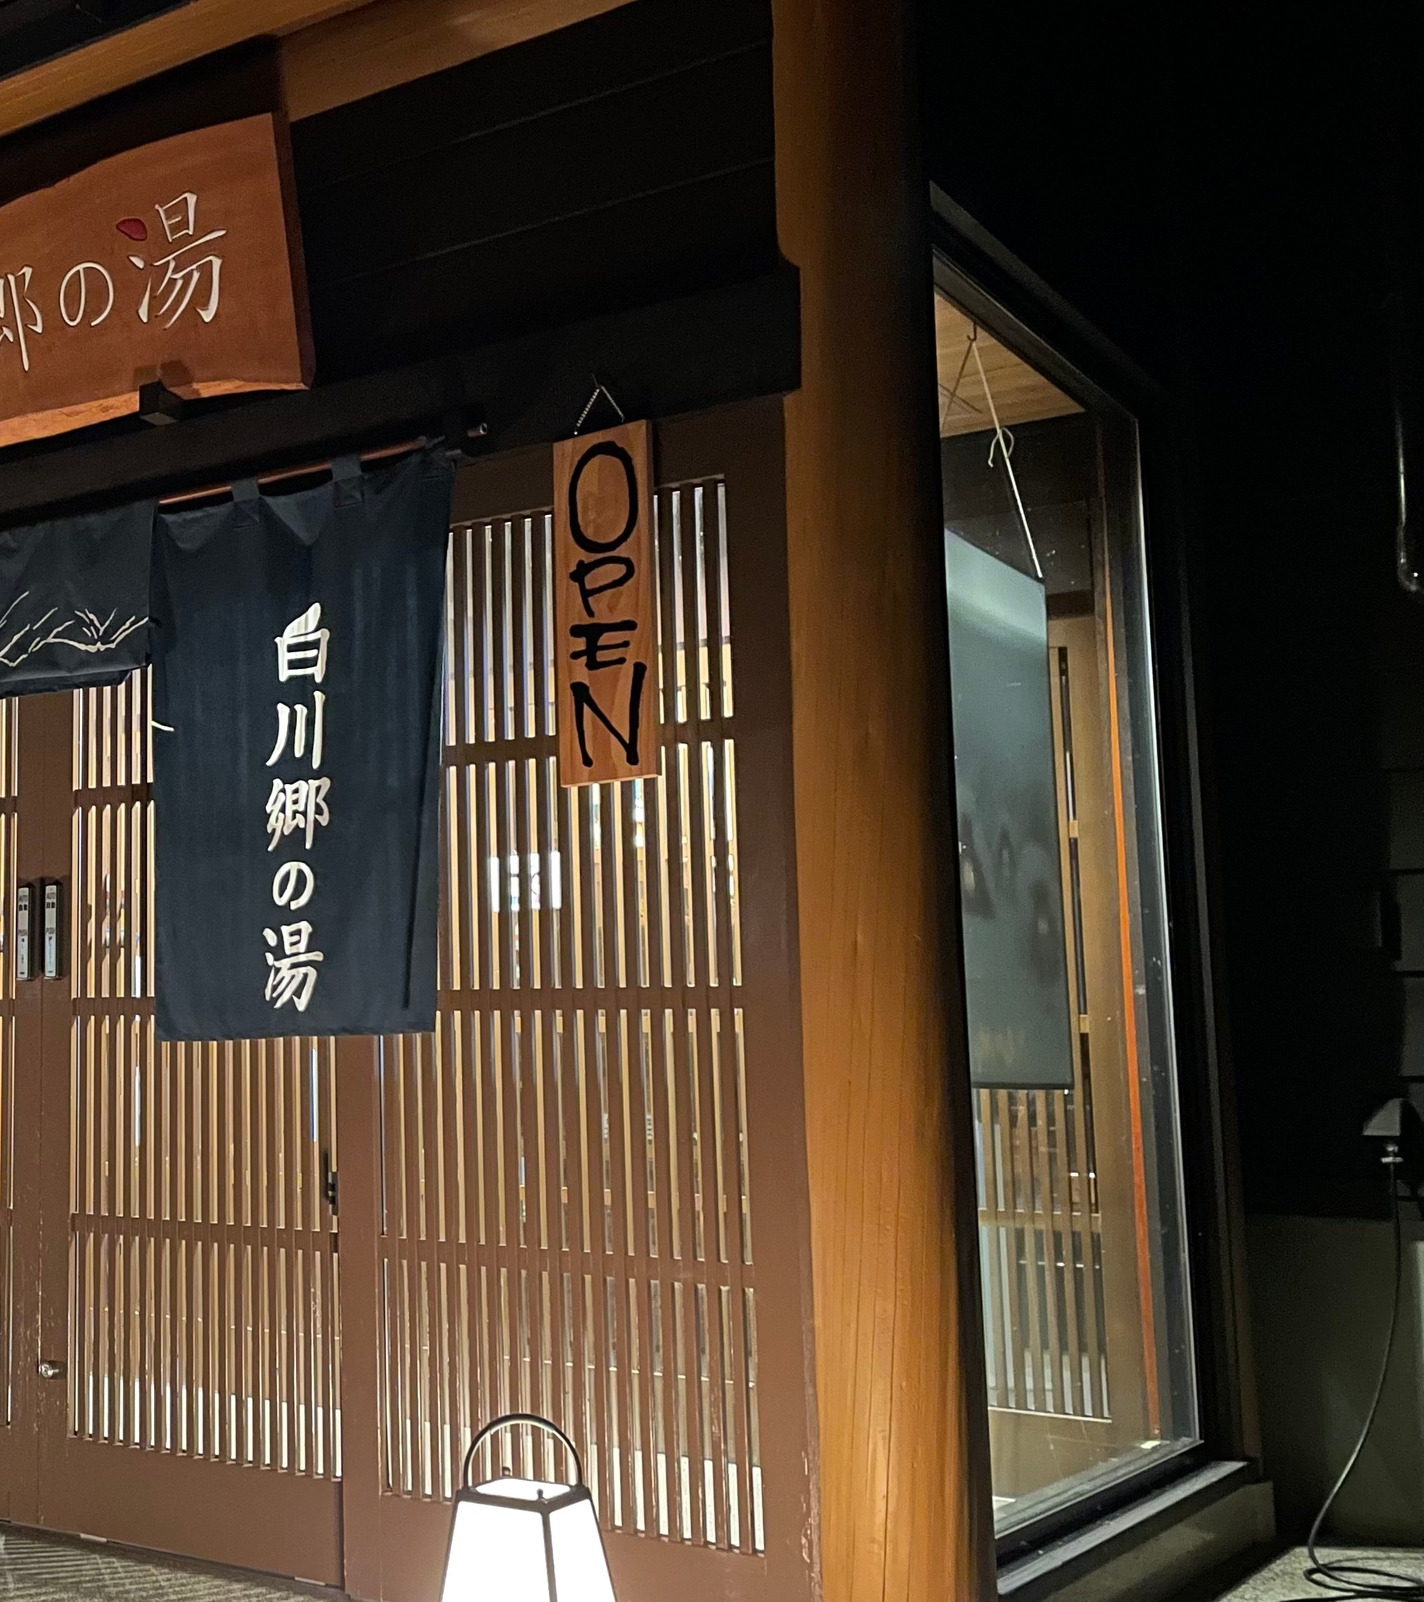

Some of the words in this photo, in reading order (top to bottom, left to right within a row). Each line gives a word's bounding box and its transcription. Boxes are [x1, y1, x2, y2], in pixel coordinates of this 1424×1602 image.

[568, 440, 648, 768] OPEN
[263, 602, 331, 1013] 白川郷の湯
